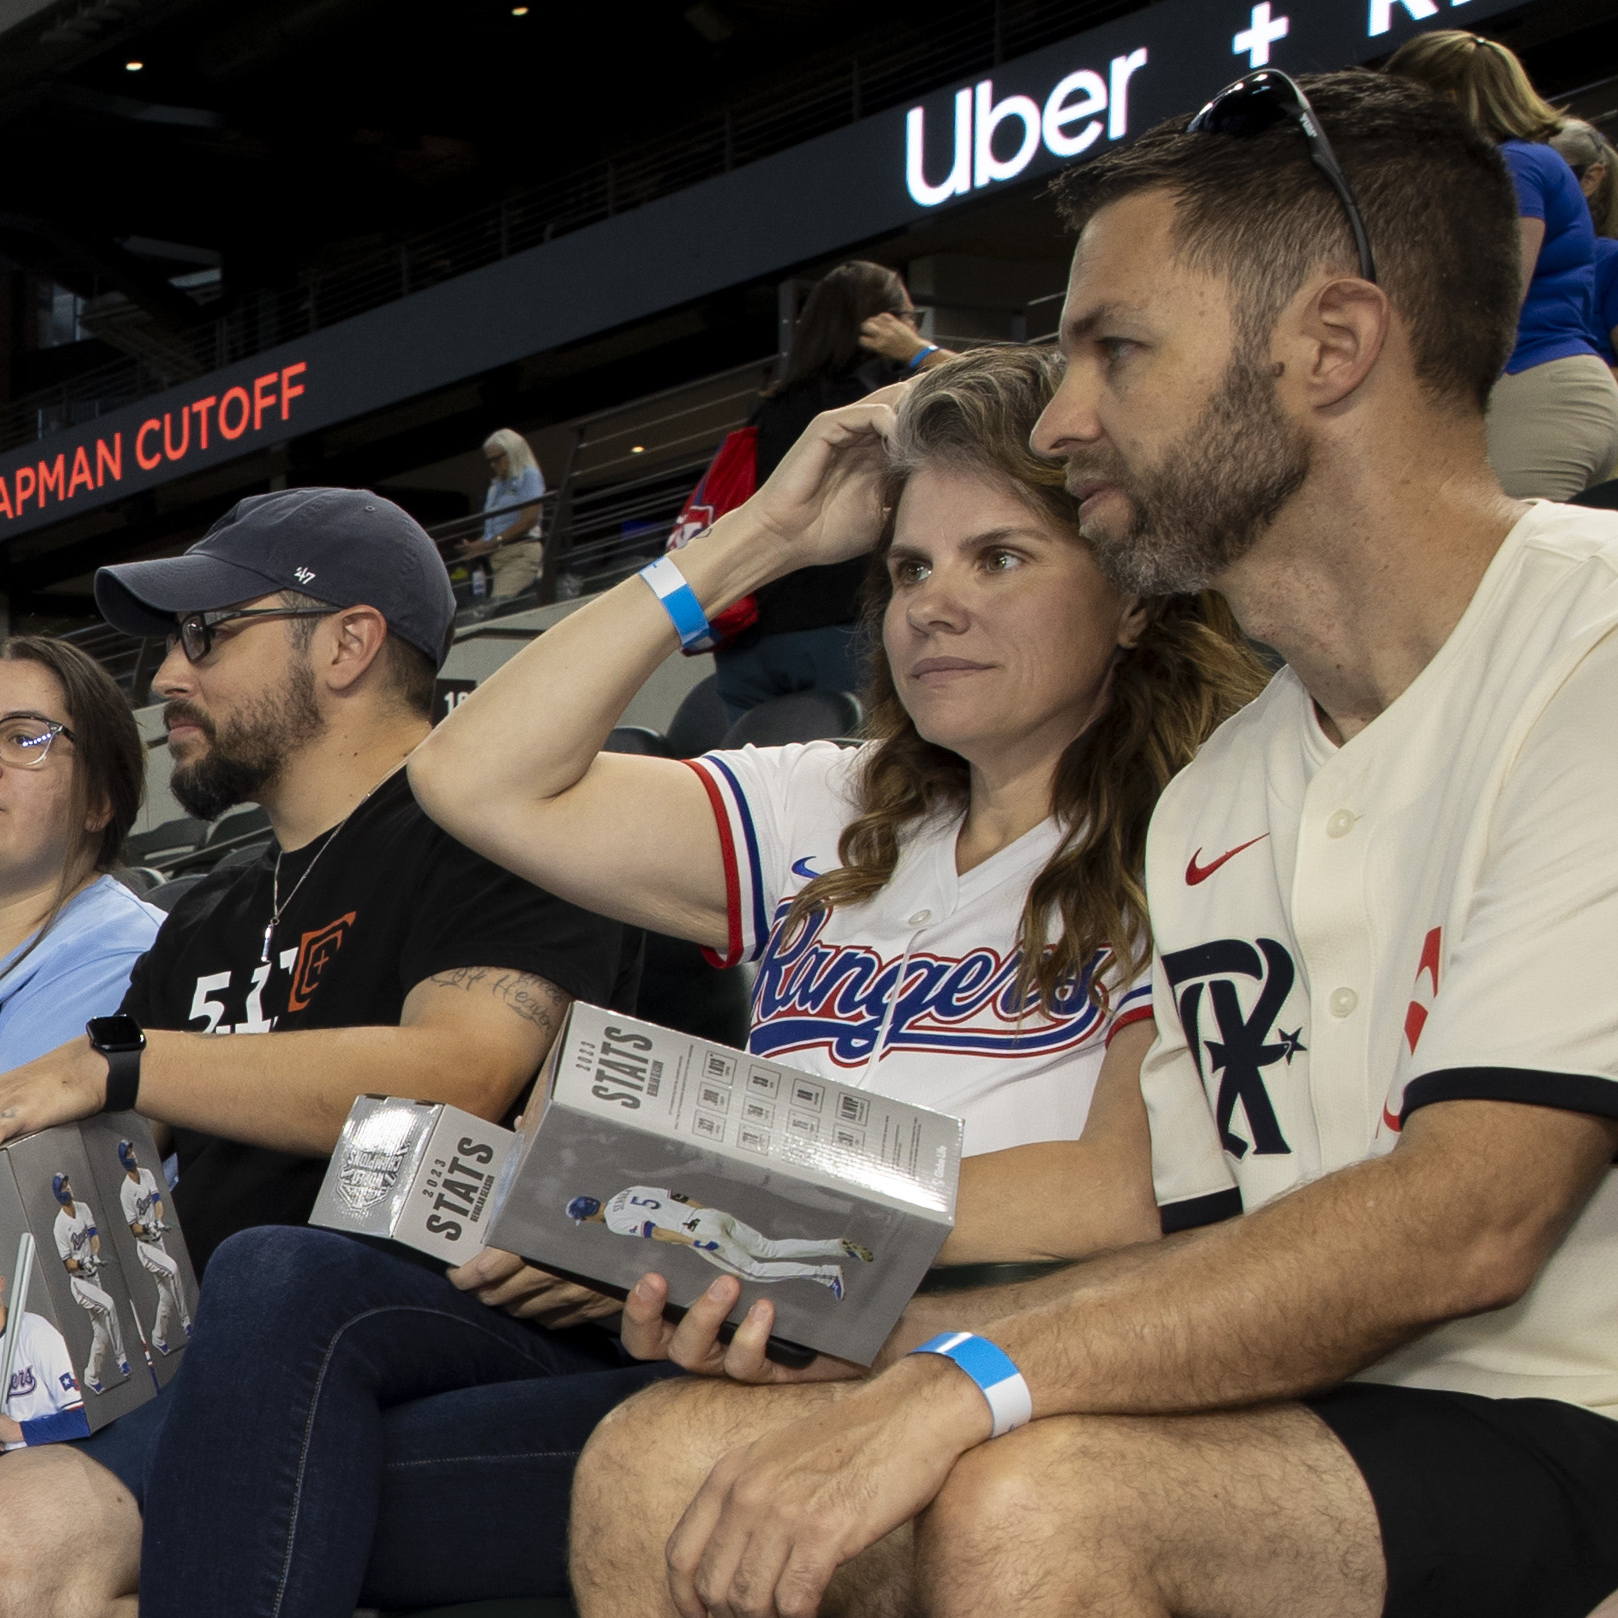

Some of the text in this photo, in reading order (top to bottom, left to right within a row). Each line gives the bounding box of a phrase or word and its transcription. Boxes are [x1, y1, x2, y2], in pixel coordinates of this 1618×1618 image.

[906, 48, 1148, 206] Uber
[135, 362, 307, 471] CUTOFF
[575, 1041, 596, 1072] 2023
[592, 1026, 653, 1110] STATS
[422, 1158, 446, 1198] 2023
[426, 1137, 494, 1242] STATS
[469, 1174, 495, 1223] REGULAR SEASON
[630, 1196, 661, 1210] 5
